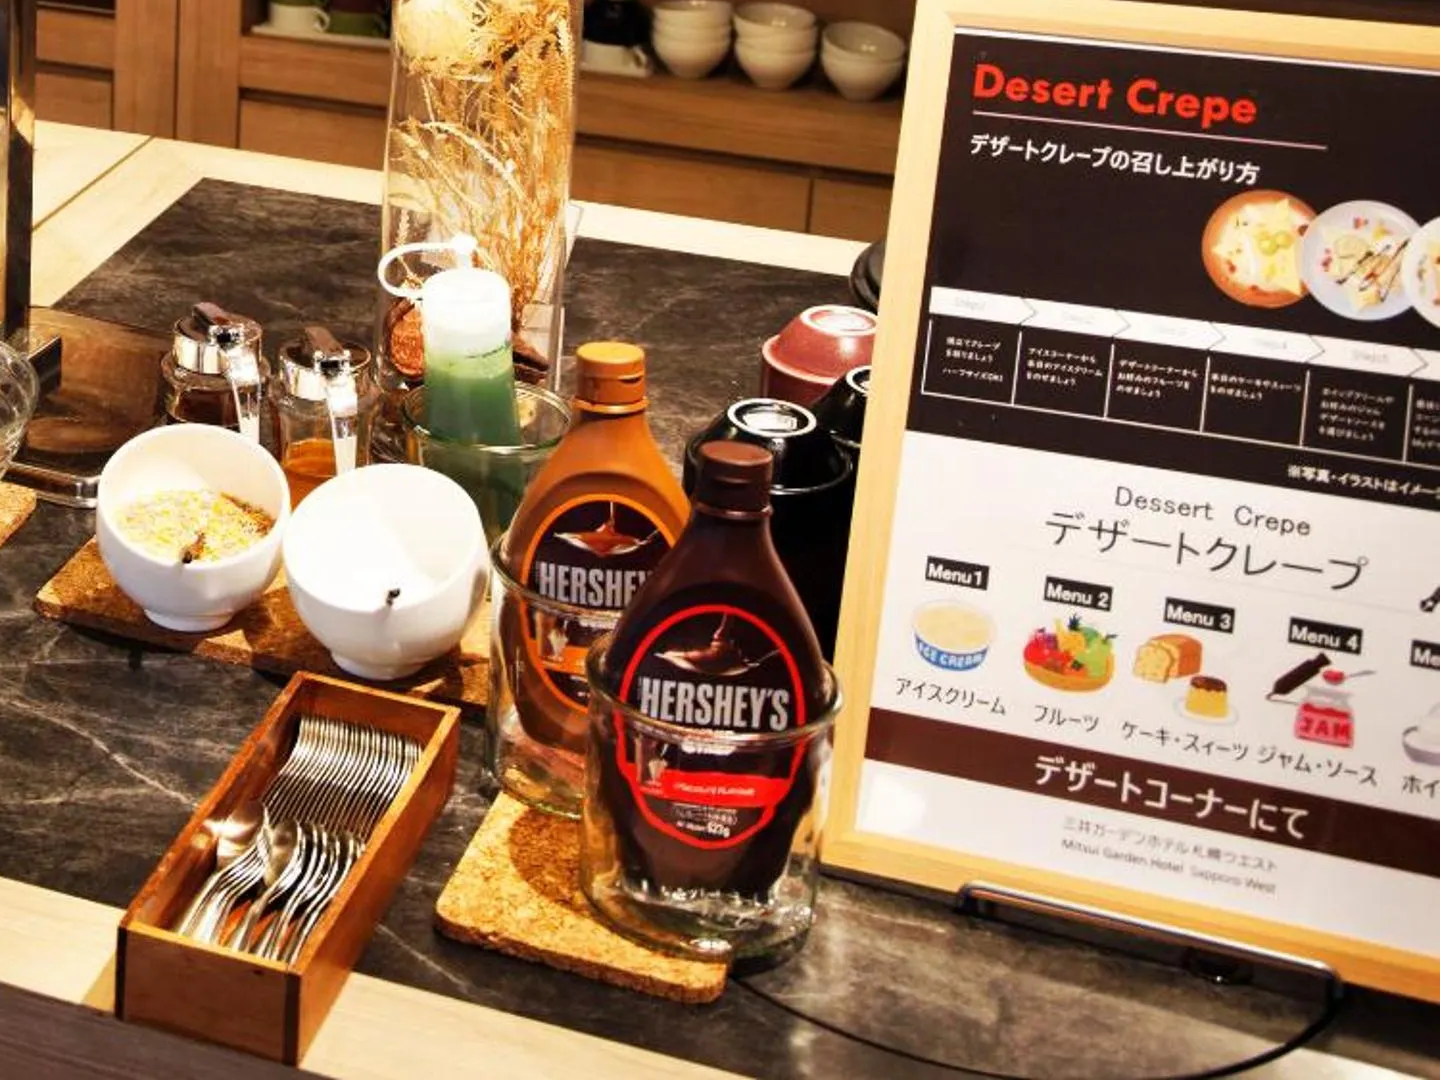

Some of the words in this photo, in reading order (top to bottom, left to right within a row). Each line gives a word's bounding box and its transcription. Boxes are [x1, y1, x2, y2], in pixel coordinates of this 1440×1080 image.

[973, 63, 1113, 110] Desert
[1126, 77, 1258, 129] Crepe
[970, 133, 1261, 186] デザートクレープの召し上がり方
[1114, 485, 1214, 521] Dessert
[1234, 505, 1312, 536] Crepe
[1045, 511, 1370, 591] デザートクレープ
[1047, 582, 1093, 605] Menu
[1097, 592, 1110, 609] 2
[1166, 603, 1215, 626] Menu
[1219, 613, 1232, 630] 3
[918, 641, 938, 664] ICE
[939, 652, 984, 668] CREAM
[1290, 623, 1341, 649] Menu
[1346, 634, 1359, 651] 4
[639, 676, 790, 732] HERSHEY'S
[895, 677, 1006, 716] アイスクリーム
[1034, 703, 1100, 733] フルーツ
[1300, 716, 1351, 739] JAM
[1257, 744, 1378, 787] ジャム・ソース
[1035, 754, 1309, 839] デザートコーナーにて
[1061, 838, 1099, 857] Mitsui
[1103, 848, 1148, 867] Garden
[1150, 857, 1184, 873] Hotel
[1191, 866, 1243, 887] Sapporo
[1245, 877, 1277, 894] West
